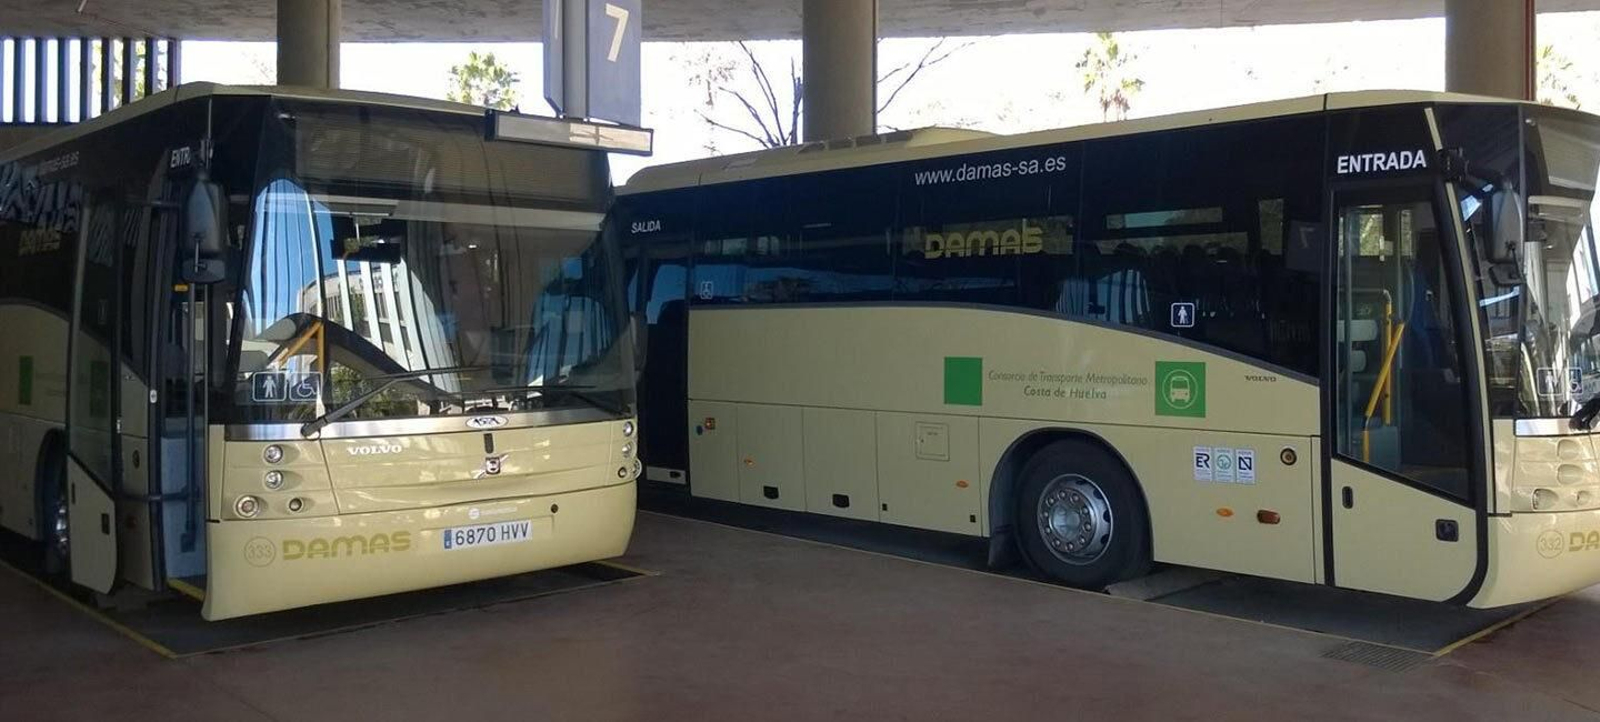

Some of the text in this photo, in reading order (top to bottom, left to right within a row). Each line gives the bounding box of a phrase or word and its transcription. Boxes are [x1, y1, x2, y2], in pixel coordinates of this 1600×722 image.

[605, 3, 629, 62] 7
[915, 156, 1066, 185] www.damas-sa.es
[1337, 150, 1427, 174] ENTRADA
[631, 220, 661, 234] SALIDA
[924, 225, 1043, 259] DAMAS
[988, 370, 1148, 386] Consorcio de Transporte Metropolitano
[1023, 385, 1107, 399] Costa de Huelva
[346, 444, 403, 455] VOLVO
[455, 522, 529, 545] 6870 HVV
[1540, 537, 1562, 551] 332
[1569, 530, 1600, 552] DA
[247, 544, 273, 559] 333
[282, 530, 412, 560] DAMAS
